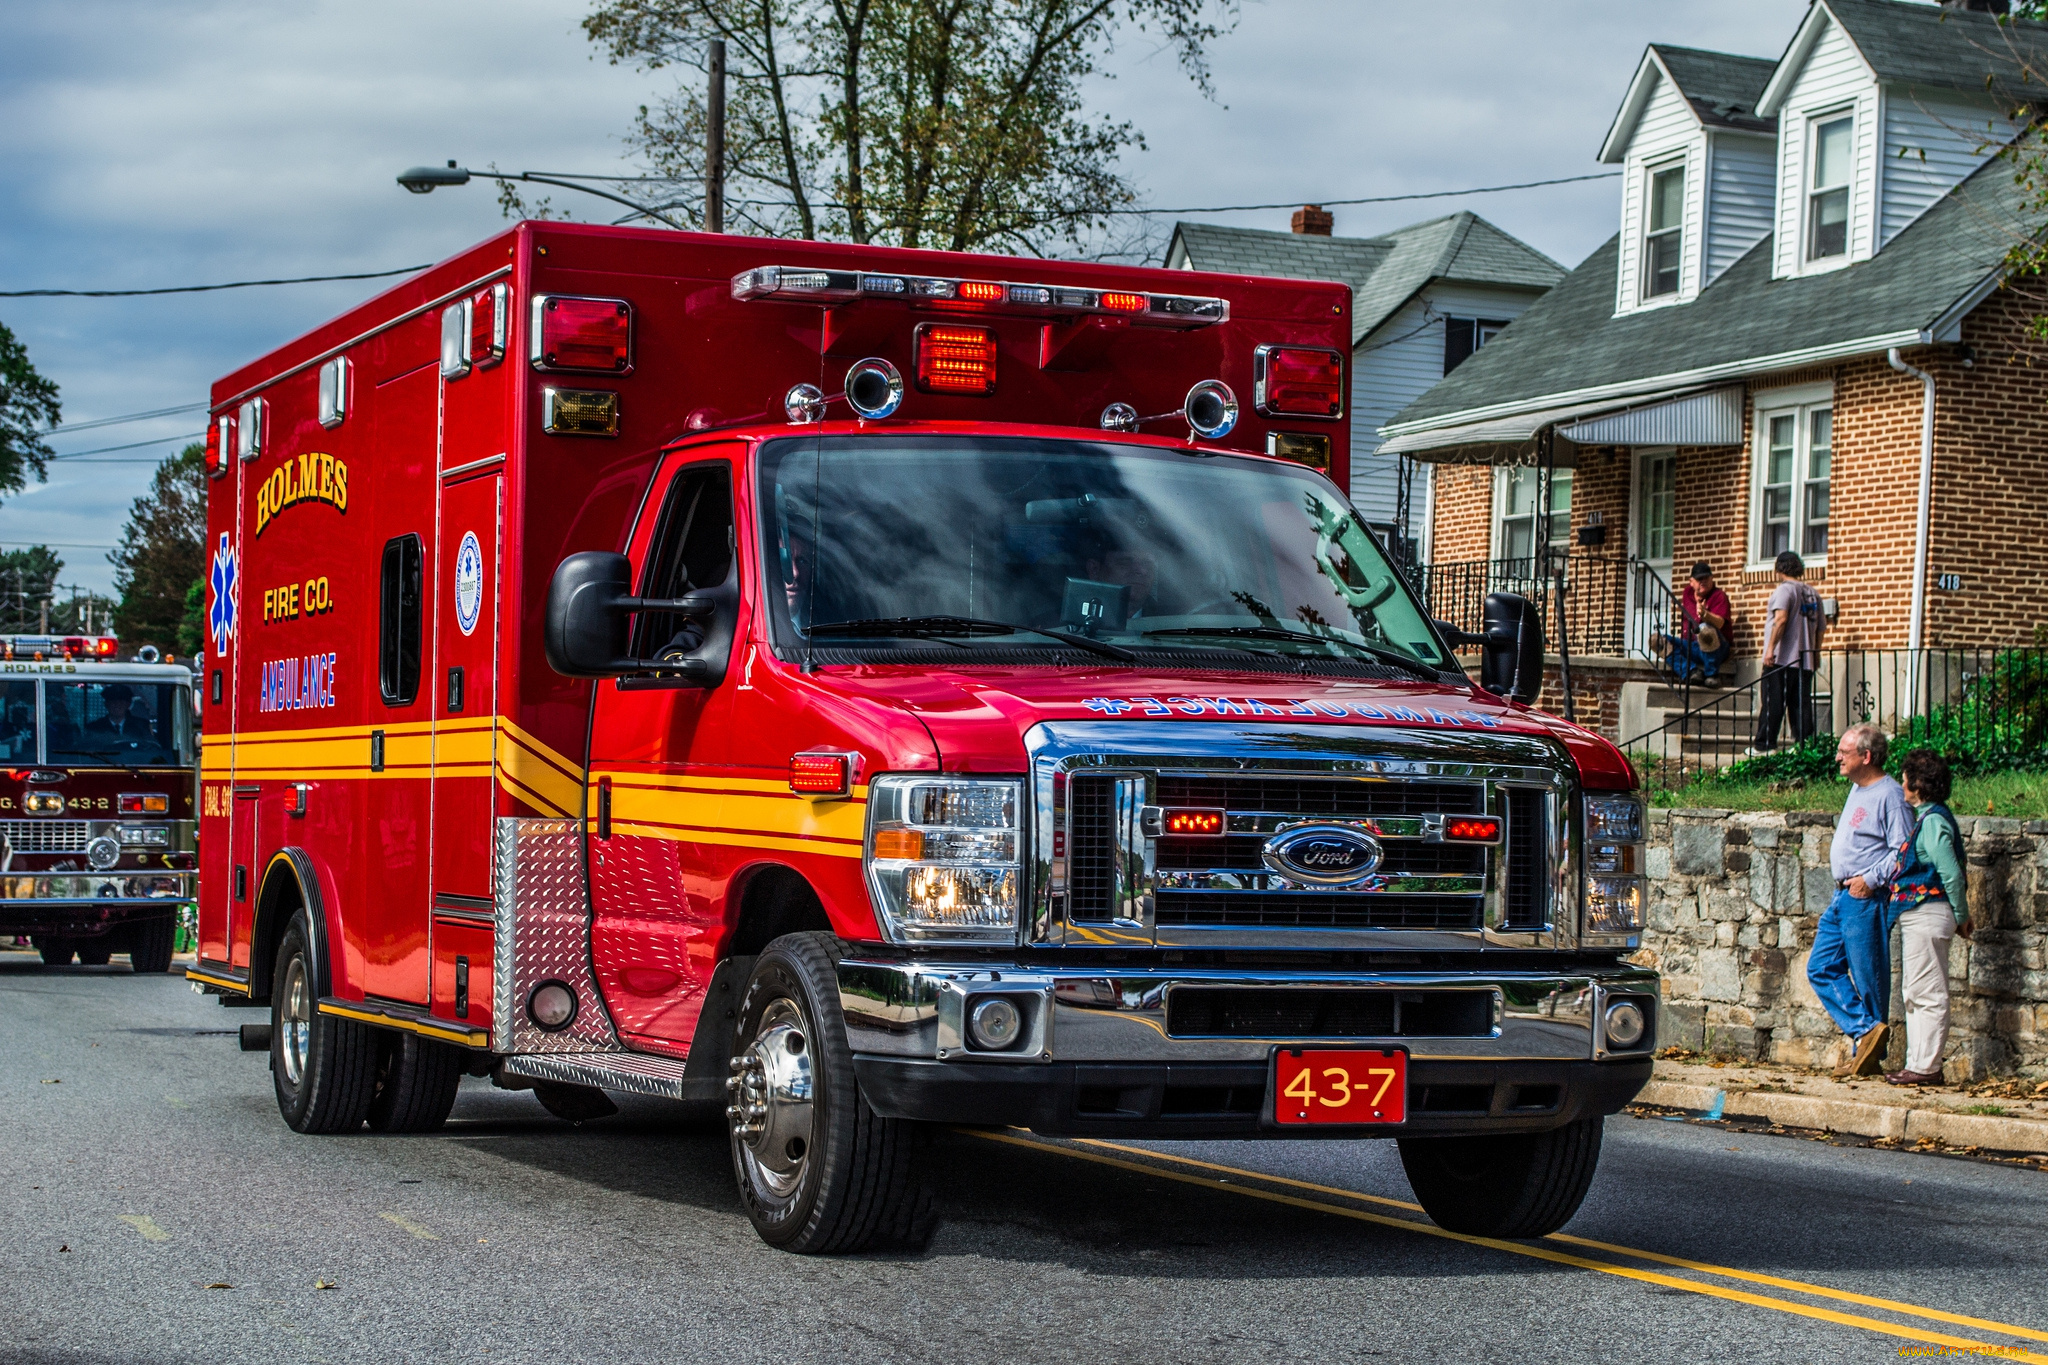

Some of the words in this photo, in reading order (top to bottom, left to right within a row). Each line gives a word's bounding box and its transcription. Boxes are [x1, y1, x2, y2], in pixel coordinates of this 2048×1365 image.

[256, 452, 348, 537] HOLMES
[264, 583, 299, 623] FIRE
[304, 576, 333, 615] CO.
[1938, 573, 1960, 590] 418
[4, 663, 77, 673] HOLMES
[260, 652, 336, 712] AMBULANCE
[204, 785, 220, 817] DIAL
[1303, 841, 1355, 865] Ford
[1283, 1067, 1397, 1107] 43-7
